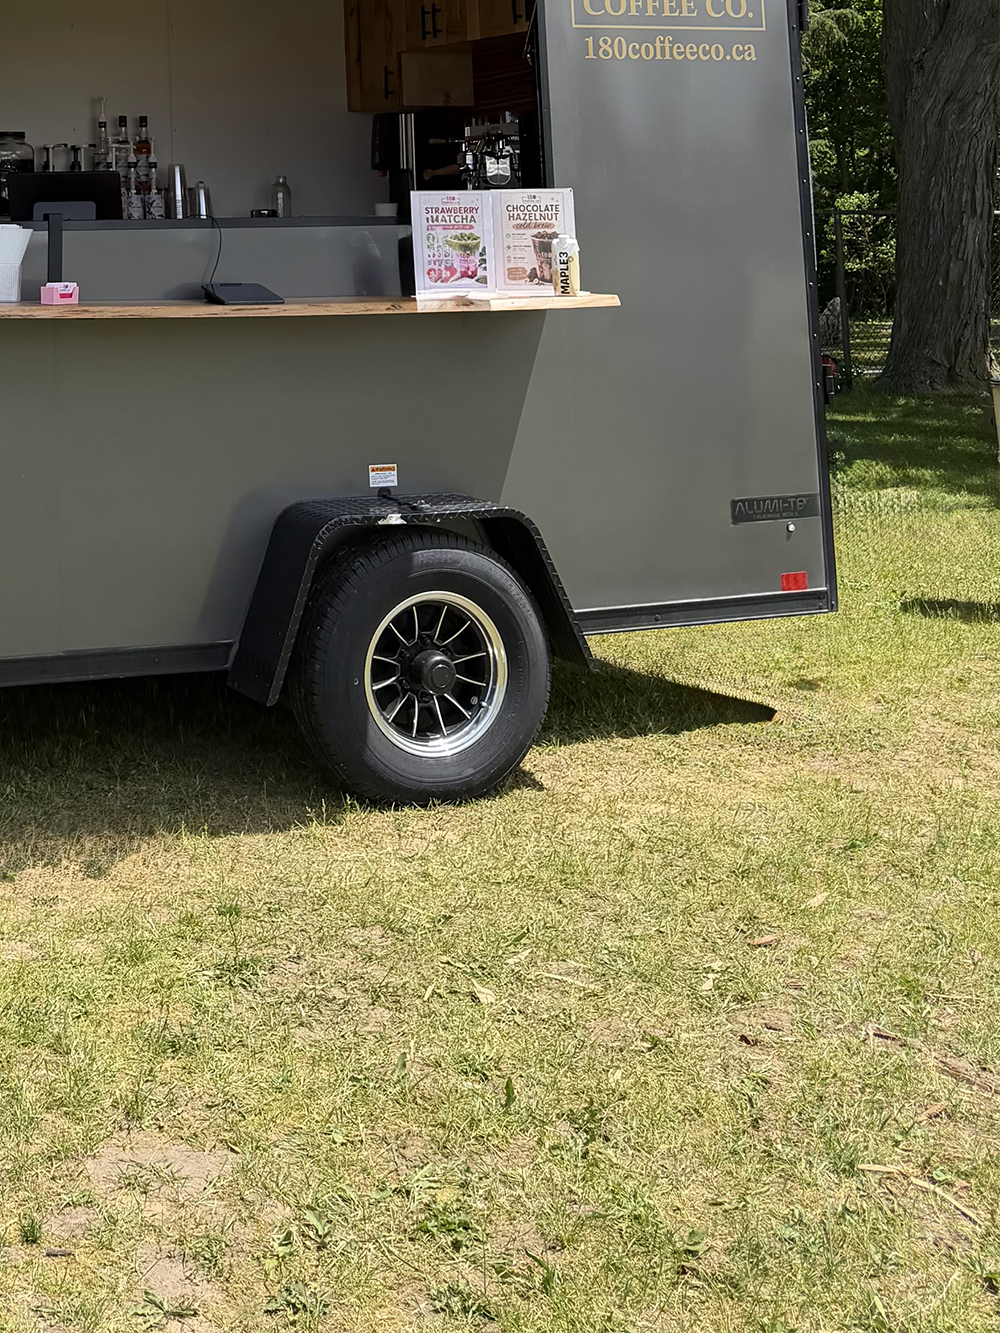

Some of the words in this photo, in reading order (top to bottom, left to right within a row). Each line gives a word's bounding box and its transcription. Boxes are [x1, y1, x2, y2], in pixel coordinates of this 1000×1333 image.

[584, 36, 757, 61] 180coffeeco.ca
[508, 213, 559, 221] HAZELNUT
[516, 220, 532, 228] cold
[559, 252, 570, 294] MAPLE3
